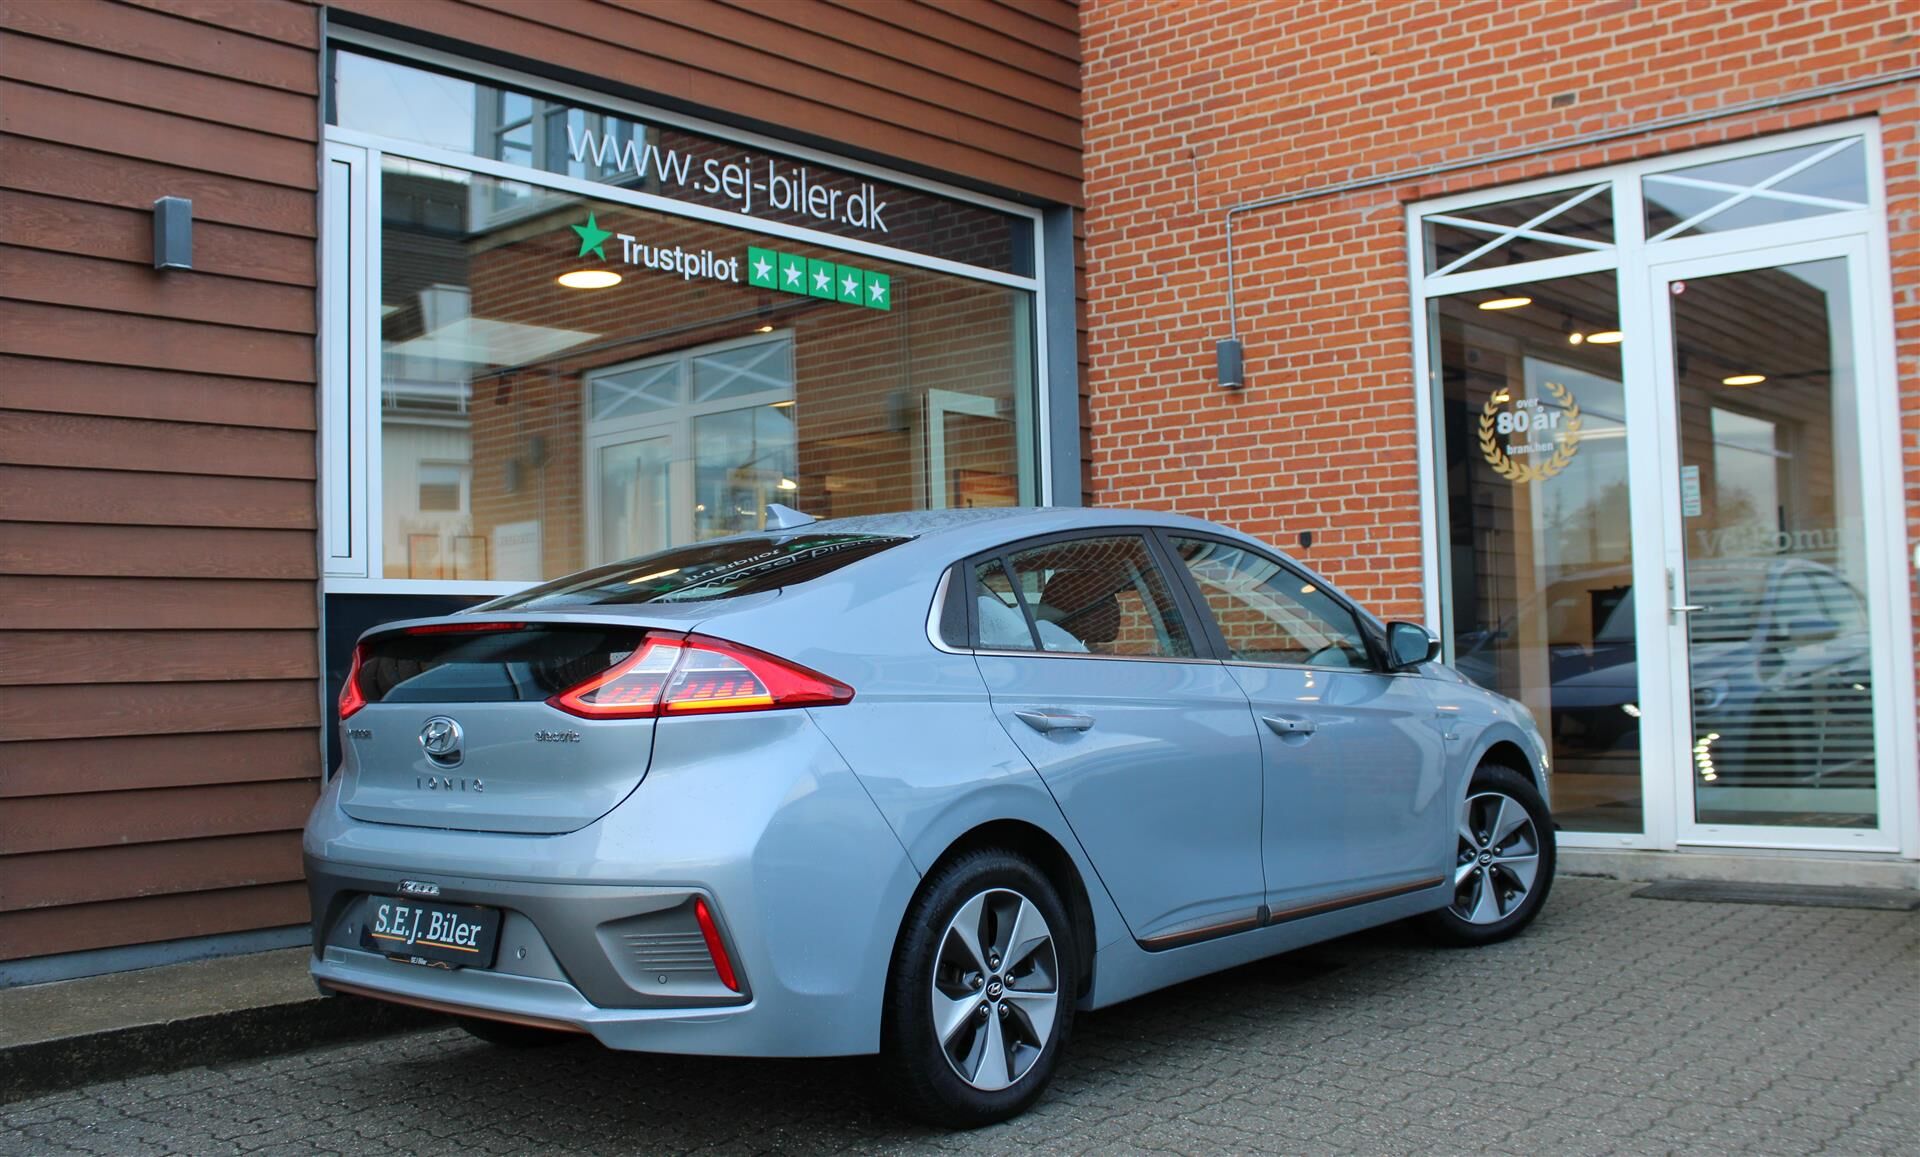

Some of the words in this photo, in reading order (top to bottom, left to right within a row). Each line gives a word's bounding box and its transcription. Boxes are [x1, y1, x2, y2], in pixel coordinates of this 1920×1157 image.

[567, 124, 888, 233] www.sej-biler.dk
[616, 232, 738, 283] Trustpilot
[1516, 398, 1539, 409] over
[1497, 411, 1529, 434] 80
[1533, 406, 1560, 430] år
[1506, 442, 1554, 455] branchen
[535, 729, 580, 742] electric
[416, 776, 483, 792] IONIQ
[375, 904, 422, 944] S.E.J.
[426, 911, 481, 946] Biler
